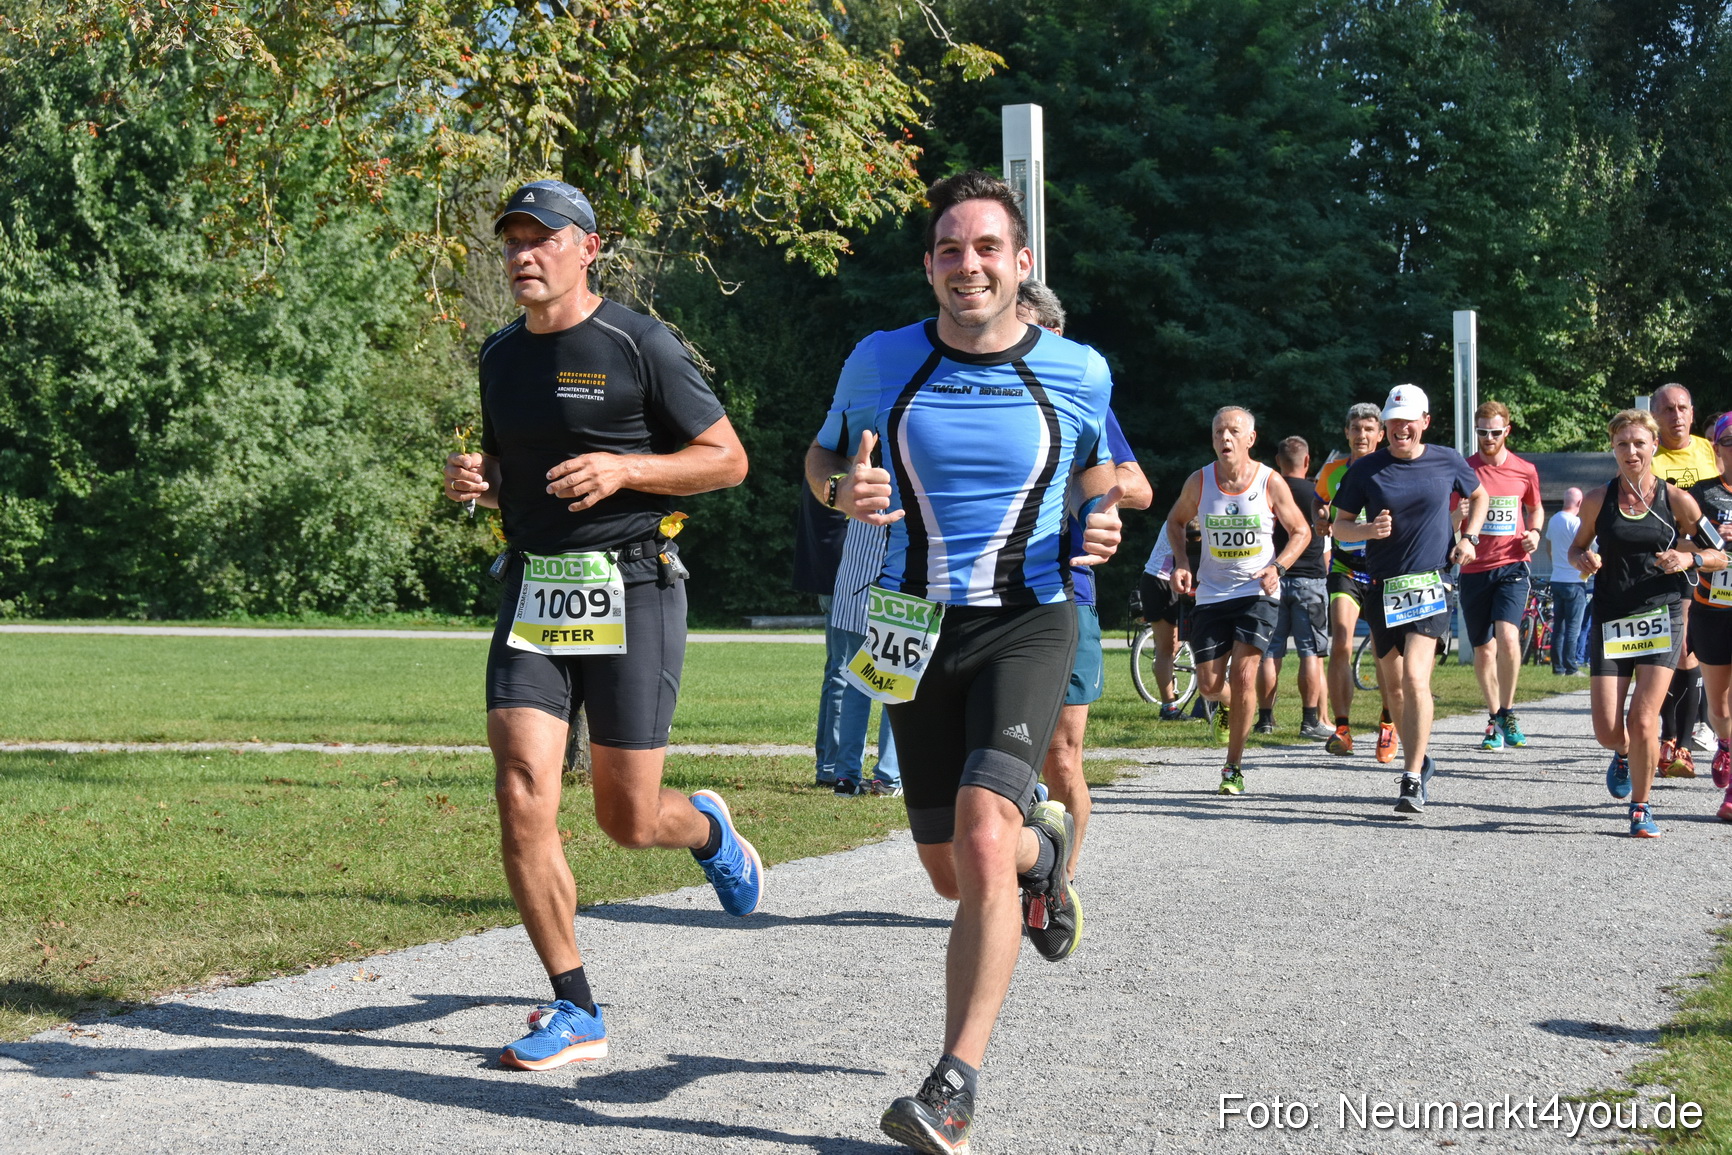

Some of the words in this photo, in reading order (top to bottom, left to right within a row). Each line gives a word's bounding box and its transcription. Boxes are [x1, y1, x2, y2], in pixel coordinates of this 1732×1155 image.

[558, 378, 606, 386] BERSCHNEIDER
[559, 371, 607, 379] BERSCHNEIDER
[556, 393, 604, 401] INNENARCHITEKTEN
[1208, 517, 1256, 527] BOCK
[1487, 510, 1512, 521] 035
[1212, 531, 1256, 546] 1200
[1217, 550, 1250, 558] STEFAN
[531, 557, 608, 578] BOCK
[1389, 575, 1432, 591] BOCK
[1720, 571, 1732, 587] 1
[534, 588, 611, 619] 1009
[1391, 588, 1436, 610] 2171
[869, 594, 930, 625] OCK
[1395, 605, 1437, 621] MICHAEL
[541, 629, 595, 642] PETER
[1611, 617, 1663, 638] 1195
[869, 626, 921, 668] 246
[1622, 640, 1654, 651] MARIA
[1002, 729, 1032, 746] adidas
